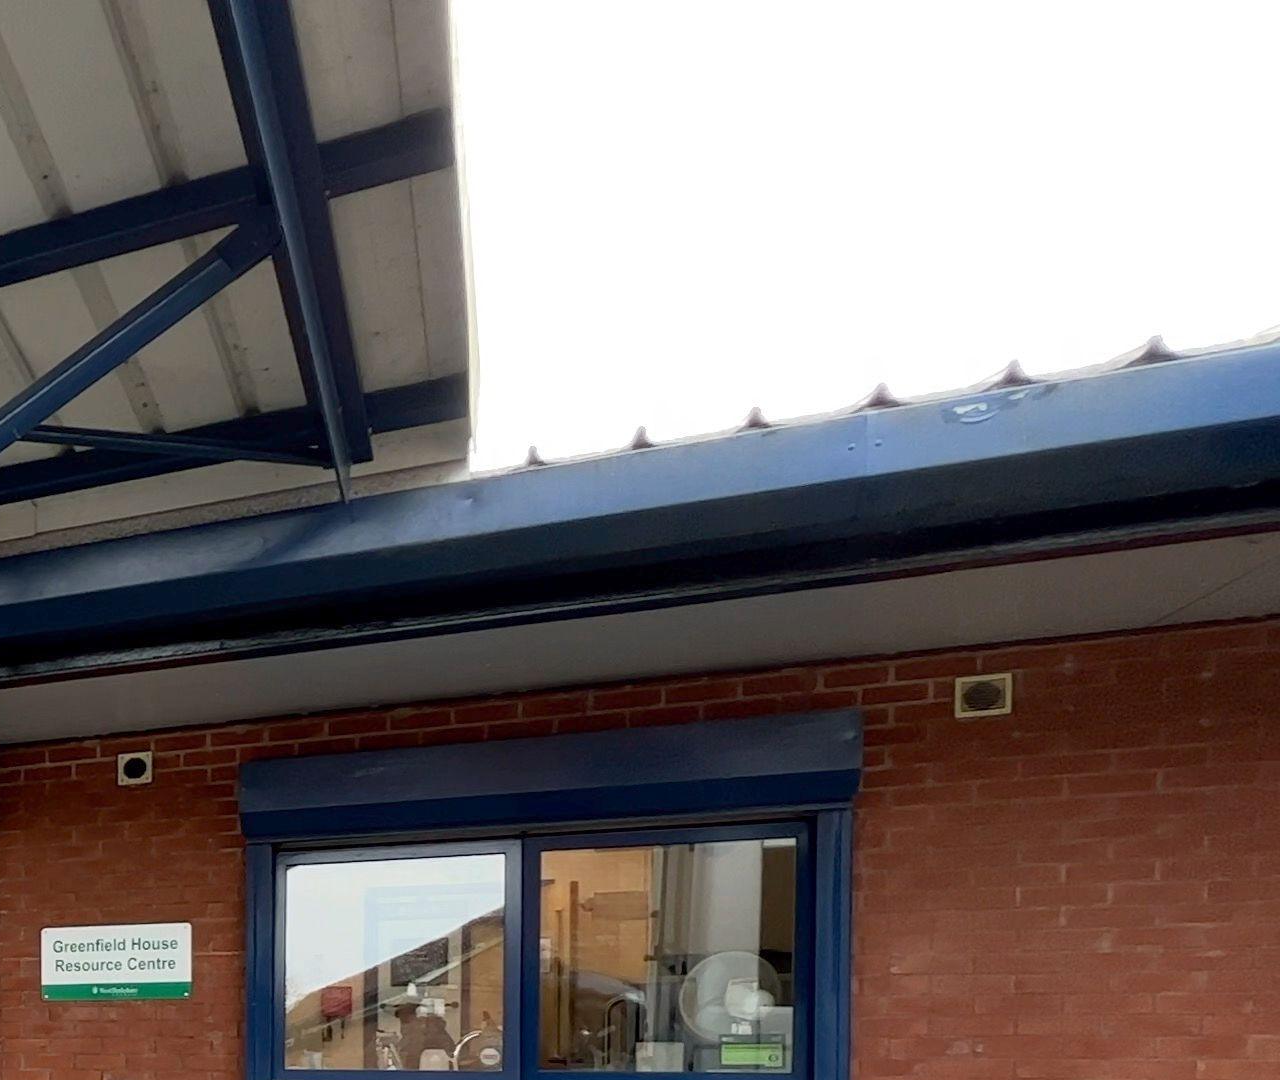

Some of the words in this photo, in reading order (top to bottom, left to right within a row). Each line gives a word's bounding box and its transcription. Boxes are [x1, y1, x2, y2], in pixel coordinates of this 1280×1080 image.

[52, 938, 126, 954] Greenfield
[131, 937, 179, 951] House
[55, 958, 122, 972] Resource
[127, 957, 176, 971] Centre
